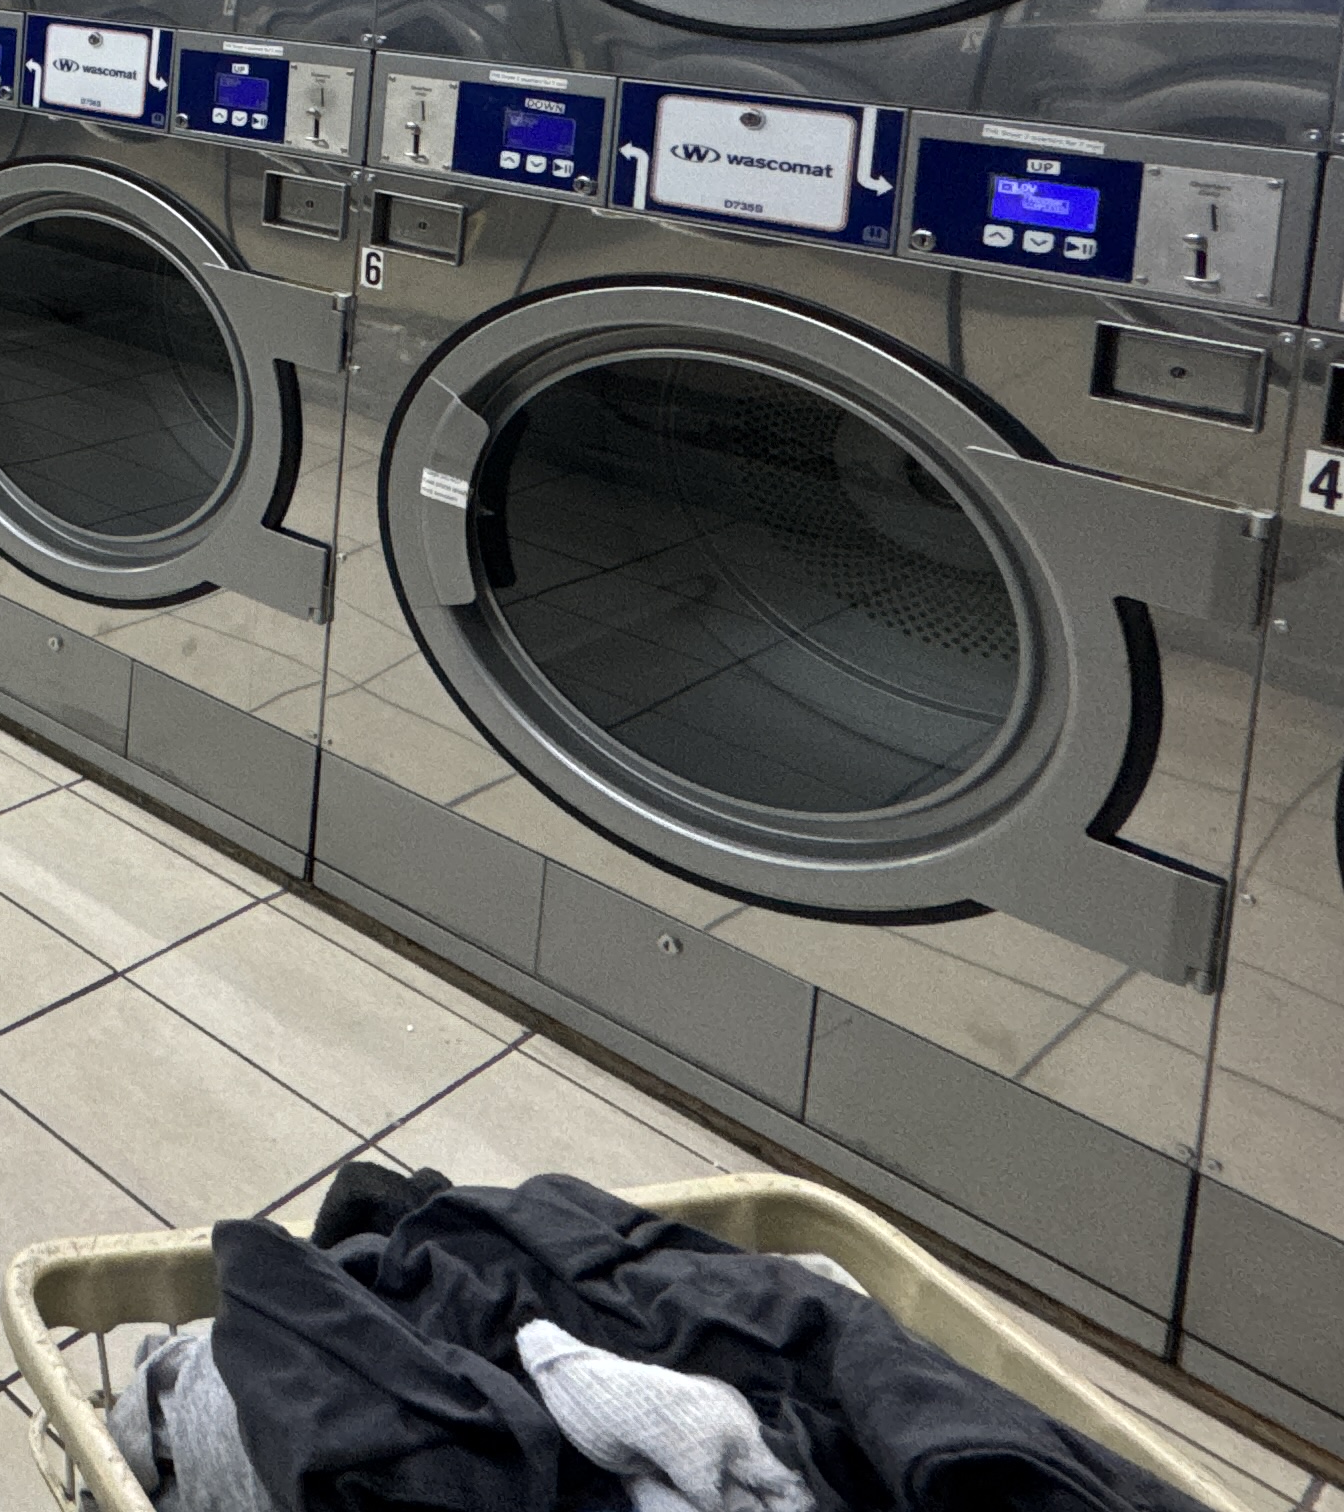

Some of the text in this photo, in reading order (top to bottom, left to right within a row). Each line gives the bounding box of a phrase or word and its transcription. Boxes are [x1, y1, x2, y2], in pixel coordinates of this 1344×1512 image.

[82, 65, 137, 80] wascomat
[527, 100, 563, 112] DOWN
[727, 153, 833, 178] wascomat
[1031, 162, 1053, 172] UP
[365, 252, 381, 285] 6
[1309, 459, 1343, 510] 4
